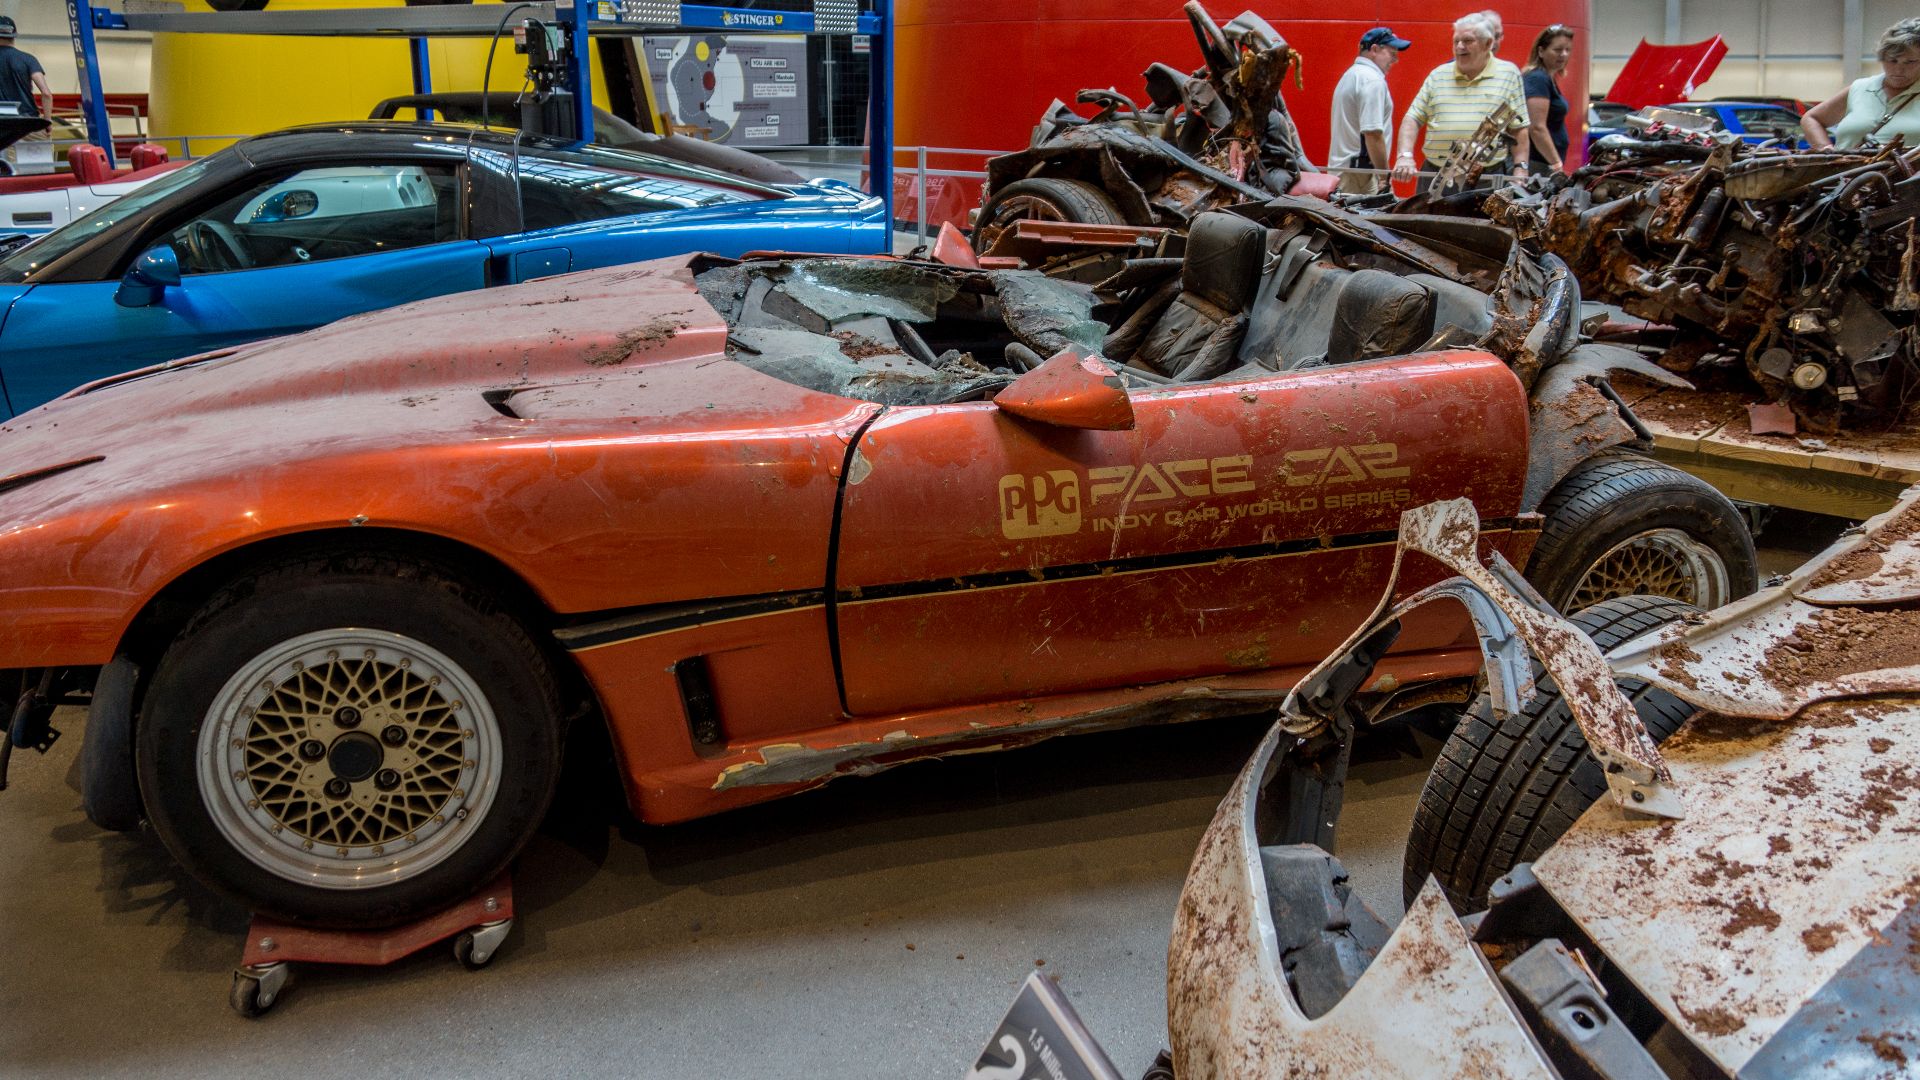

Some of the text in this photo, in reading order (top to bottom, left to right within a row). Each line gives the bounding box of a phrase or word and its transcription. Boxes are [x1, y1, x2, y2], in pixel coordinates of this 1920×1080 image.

[733, 13, 775, 26] STINGER
[1088, 442, 1411, 506] PACE CAR
[1003, 472, 1077, 526] PPG
[1093, 488, 1411, 532] INDY CAR WORLD SERIES
[1028, 1027, 1044, 1052] 1.5
